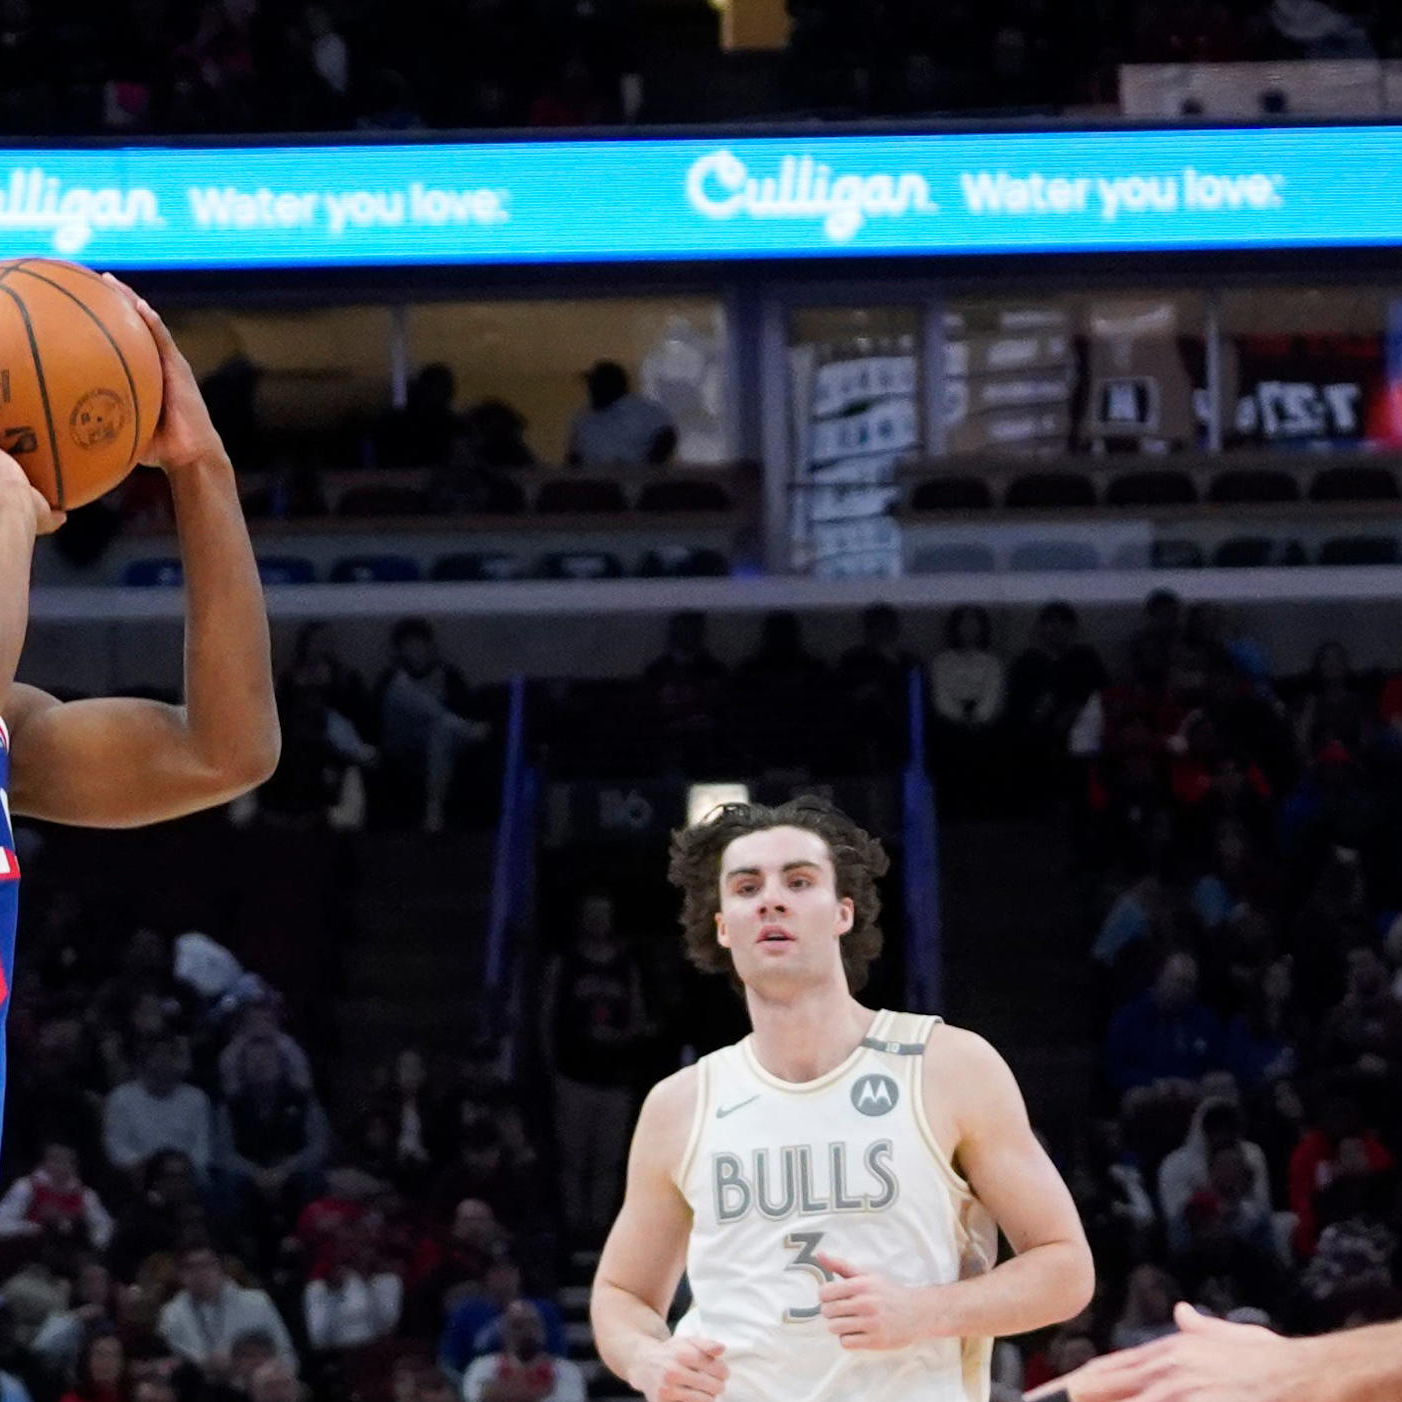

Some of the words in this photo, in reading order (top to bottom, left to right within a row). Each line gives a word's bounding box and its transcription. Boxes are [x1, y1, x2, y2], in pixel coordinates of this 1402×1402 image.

[188, 185, 316, 230] Water
[325, 190, 402, 235] you
[960, 171, 1091, 215] Water
[1099, 175, 1177, 221] you
[711, 1138, 900, 1225] BULLS
[781, 1230, 834, 1325] 3
